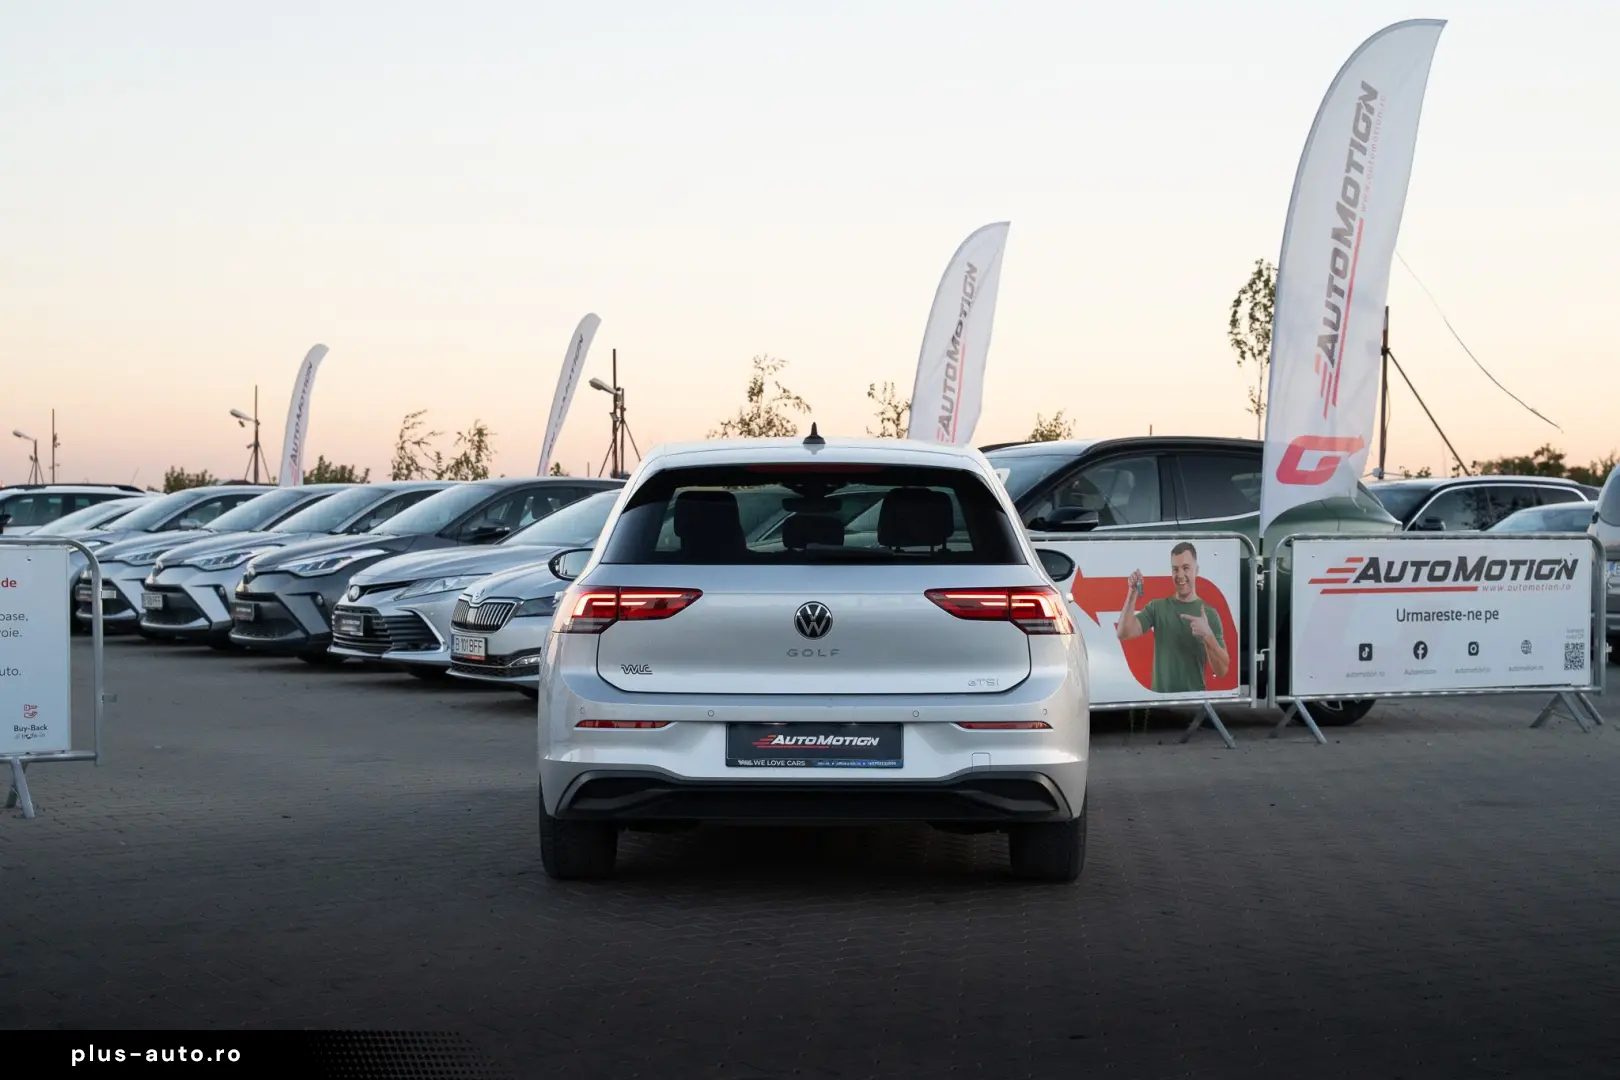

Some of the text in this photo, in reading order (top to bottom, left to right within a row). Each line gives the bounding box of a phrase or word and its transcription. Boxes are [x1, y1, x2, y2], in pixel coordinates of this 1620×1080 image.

[1, 577, 17, 588] de
[1396, 608, 1499, 623] Urmareste-ne pe
[787, 649, 841, 658] GOLF
[13, 724, 48, 733] Buy-Back
